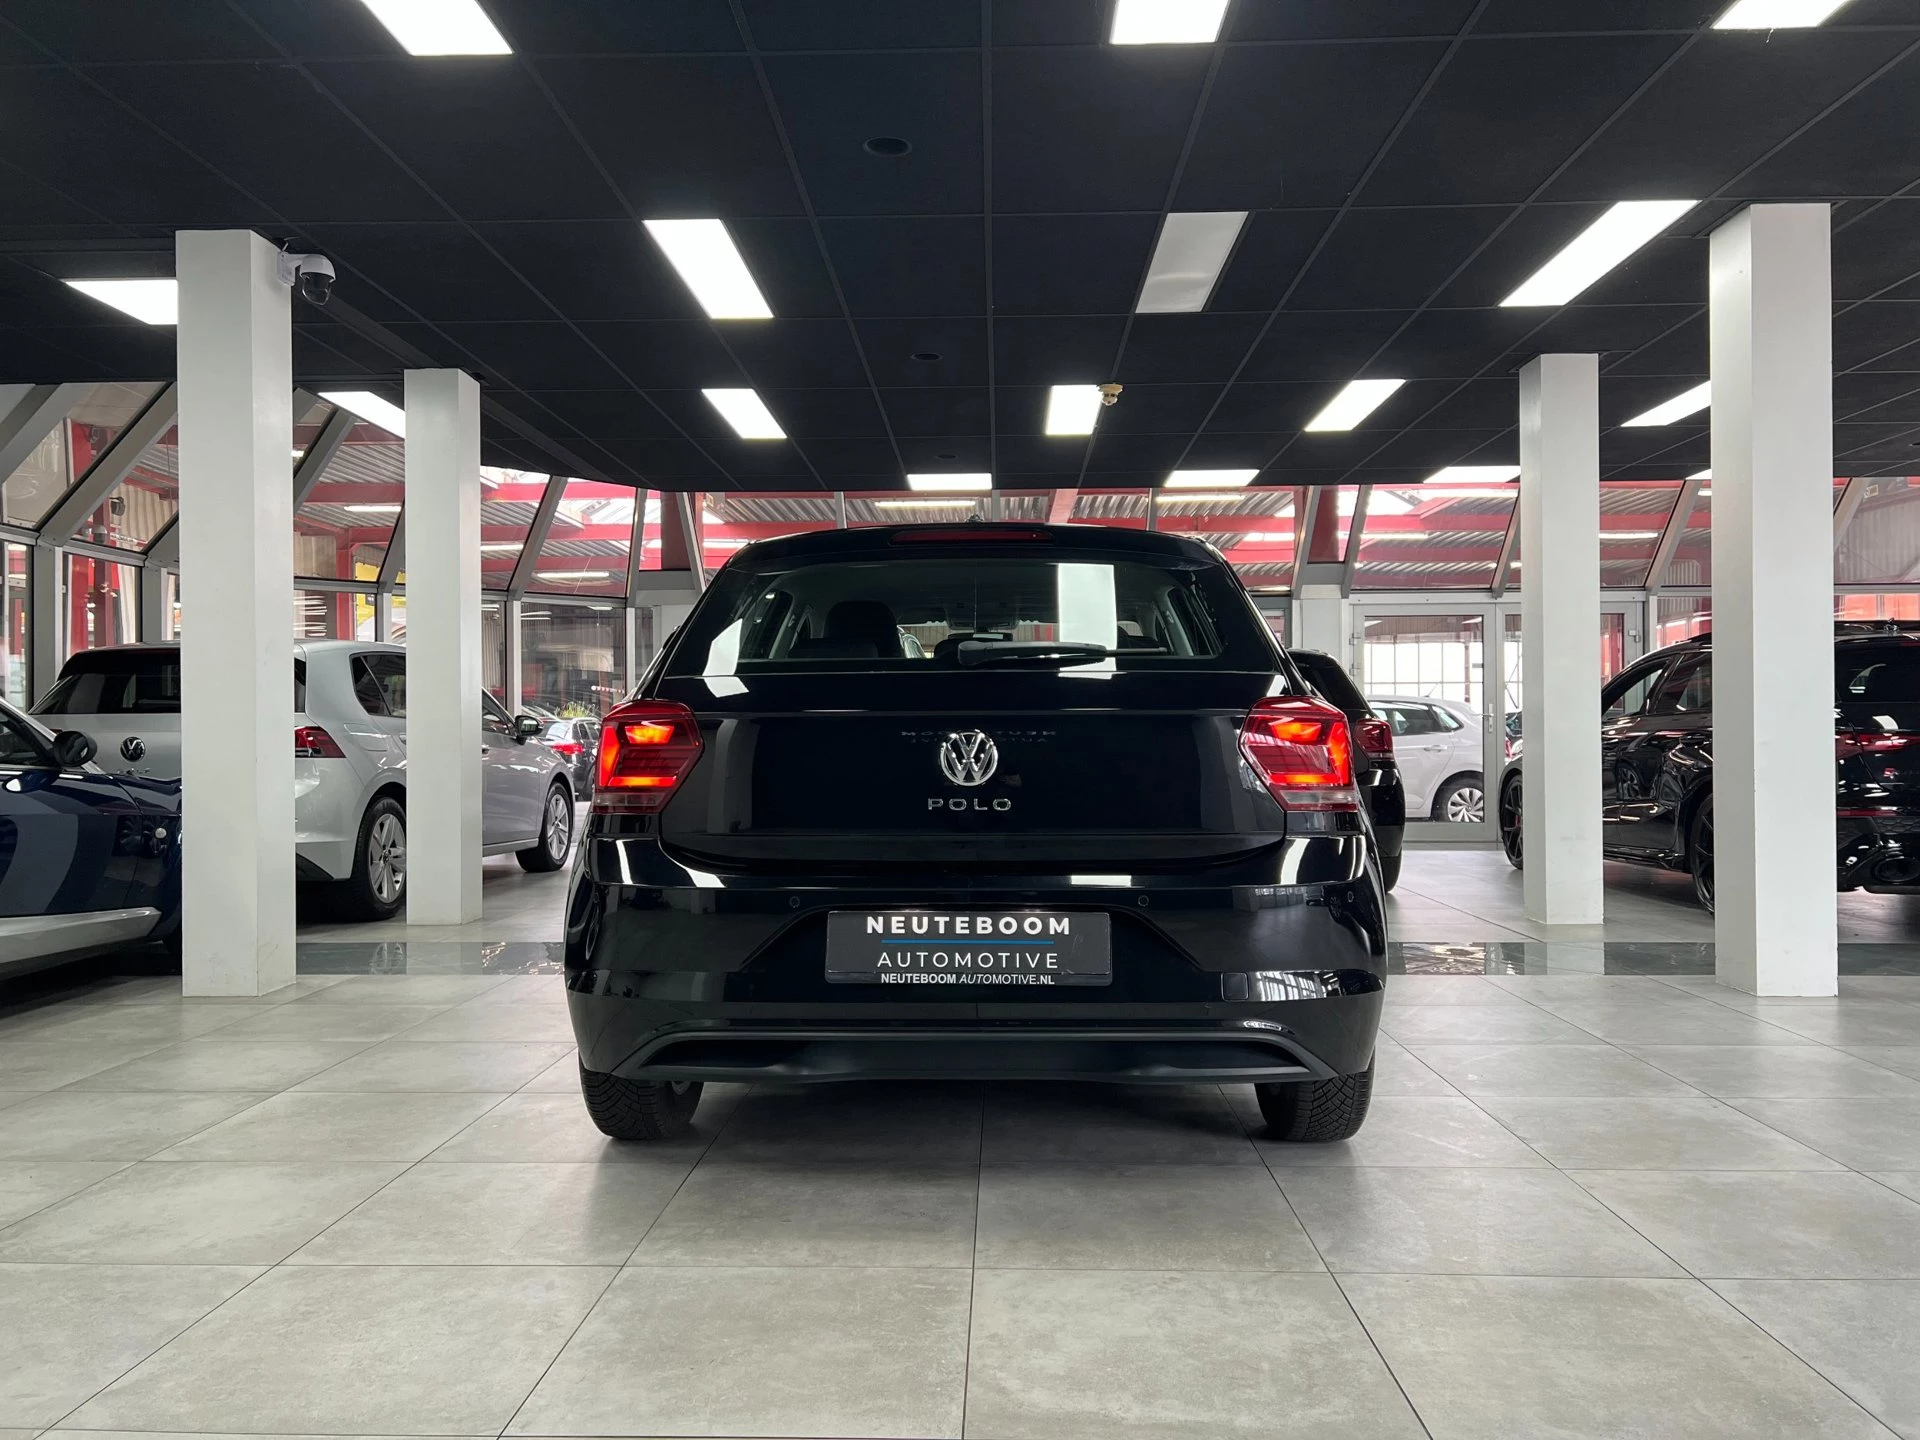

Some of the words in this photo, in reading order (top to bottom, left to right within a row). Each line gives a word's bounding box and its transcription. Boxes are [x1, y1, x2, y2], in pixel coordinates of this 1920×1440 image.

[940, 731, 998, 786] VW
[927, 798, 1012, 811] POLO
[866, 916, 1070, 935] NEUTEBOOM
[877, 952, 1058, 969] AUTOMOTIVE
[881, 973, 956, 984] NEUTEBOOM
[959, 974, 1055, 985] AUTOMOTIVE.NL
